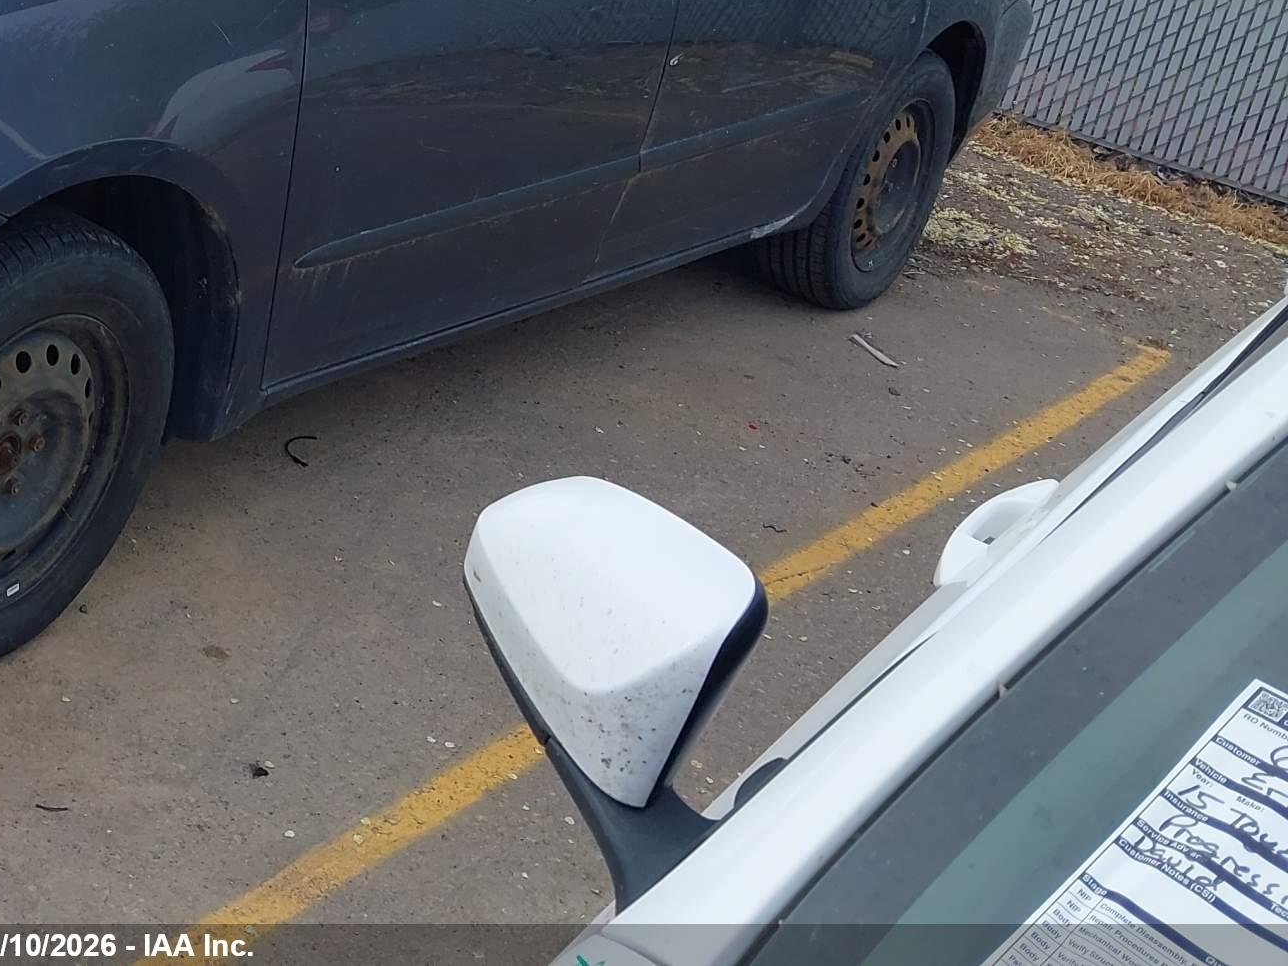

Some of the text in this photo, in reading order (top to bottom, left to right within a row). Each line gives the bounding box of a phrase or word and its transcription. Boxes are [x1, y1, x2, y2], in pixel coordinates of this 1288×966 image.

[1259, 722, 1288, 741] Numb
[1215, 737, 1261, 766] Customer
[1192, 768, 1213, 788] Year:
[1195, 759, 1228, 784] Vehicle
[1164, 790, 1209, 822] Insurance
[1235, 795, 1265, 812] Make:
[1136, 818, 1170, 845] Service
[1118, 838, 1216, 903] Customer Notes (CSI)
[1082, 874, 1108, 896] Stage
[1053, 908, 1072, 928] Body
[1100, 903, 1136, 930] Complete
[1042, 920, 1062, 939] Body
[1089, 915, 1160, 964] Repair Procedures
[1030, 931, 1051, 951] Body
[1068, 938, 1090, 955] Verify
[1078, 926, 1122, 956] Mechanical
[1019, 942, 1040, 963] Body
